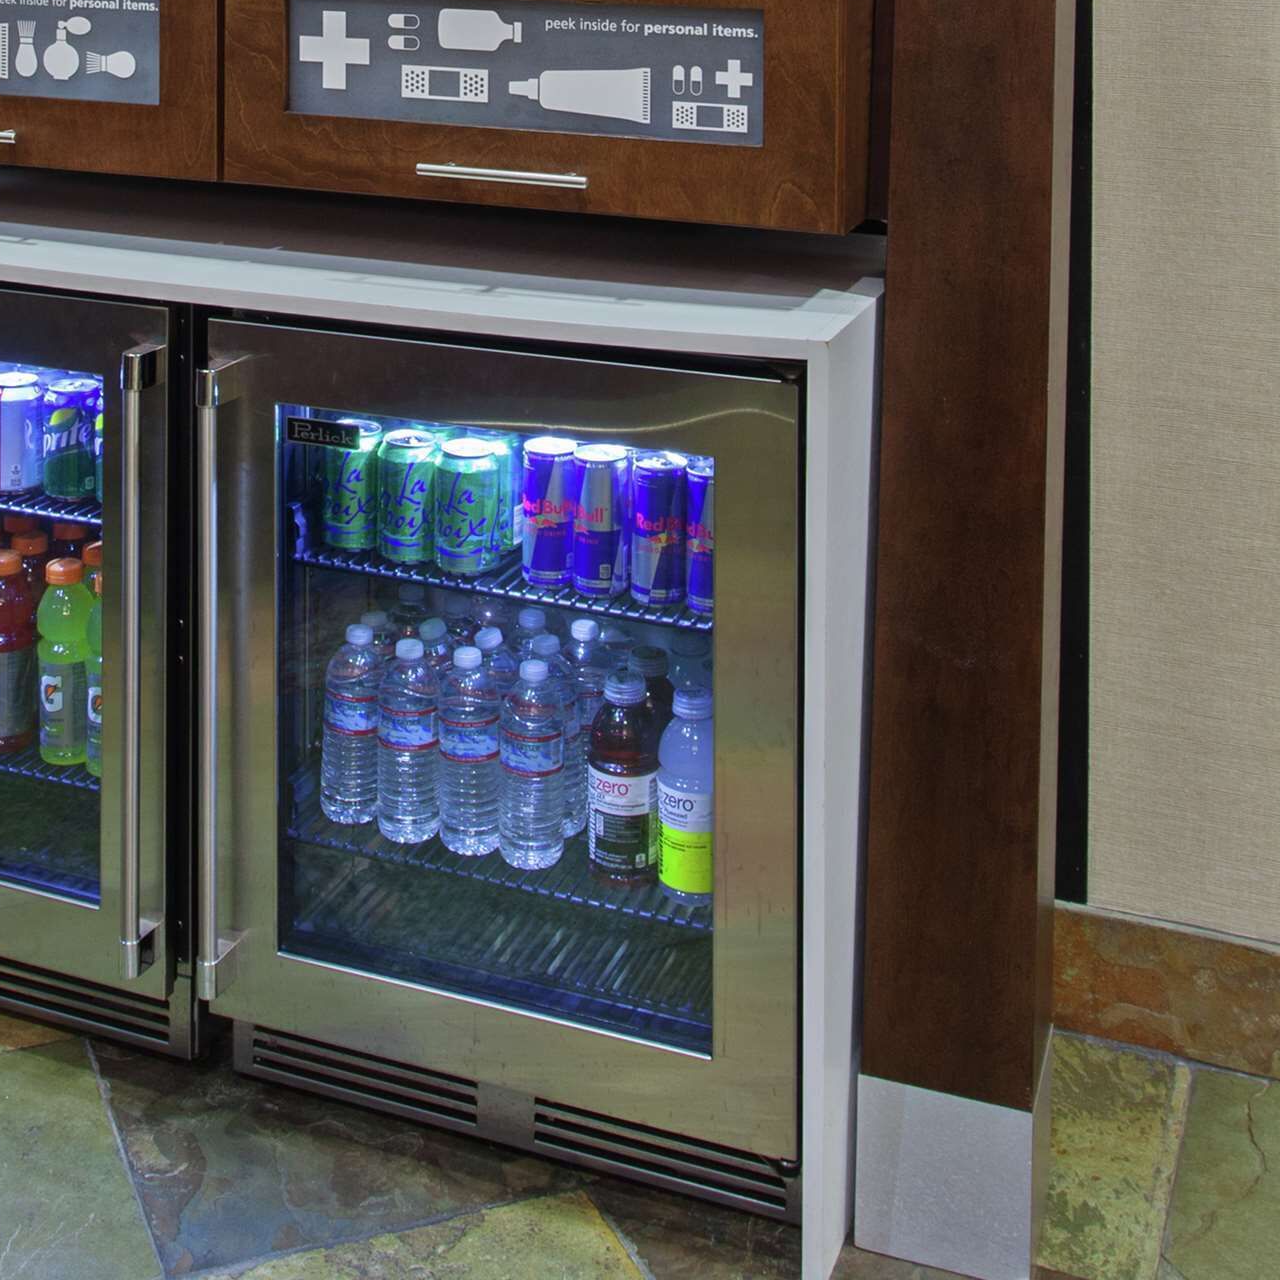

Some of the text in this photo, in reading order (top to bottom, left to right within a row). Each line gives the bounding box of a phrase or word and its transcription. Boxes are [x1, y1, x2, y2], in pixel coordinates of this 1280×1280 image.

[122, 0, 159, 11] items.
[545, 18, 759, 38] peek inside for personal items.
[42, 418, 93, 458] prite
[292, 421, 353, 444] Perlick
[335, 451, 363, 494] La
[395, 462, 427, 506] La
[445, 472, 475, 516] La
[636, 512, 664, 531] Red
[596, 778, 629, 796] zero
[664, 793, 694, 812] zero
